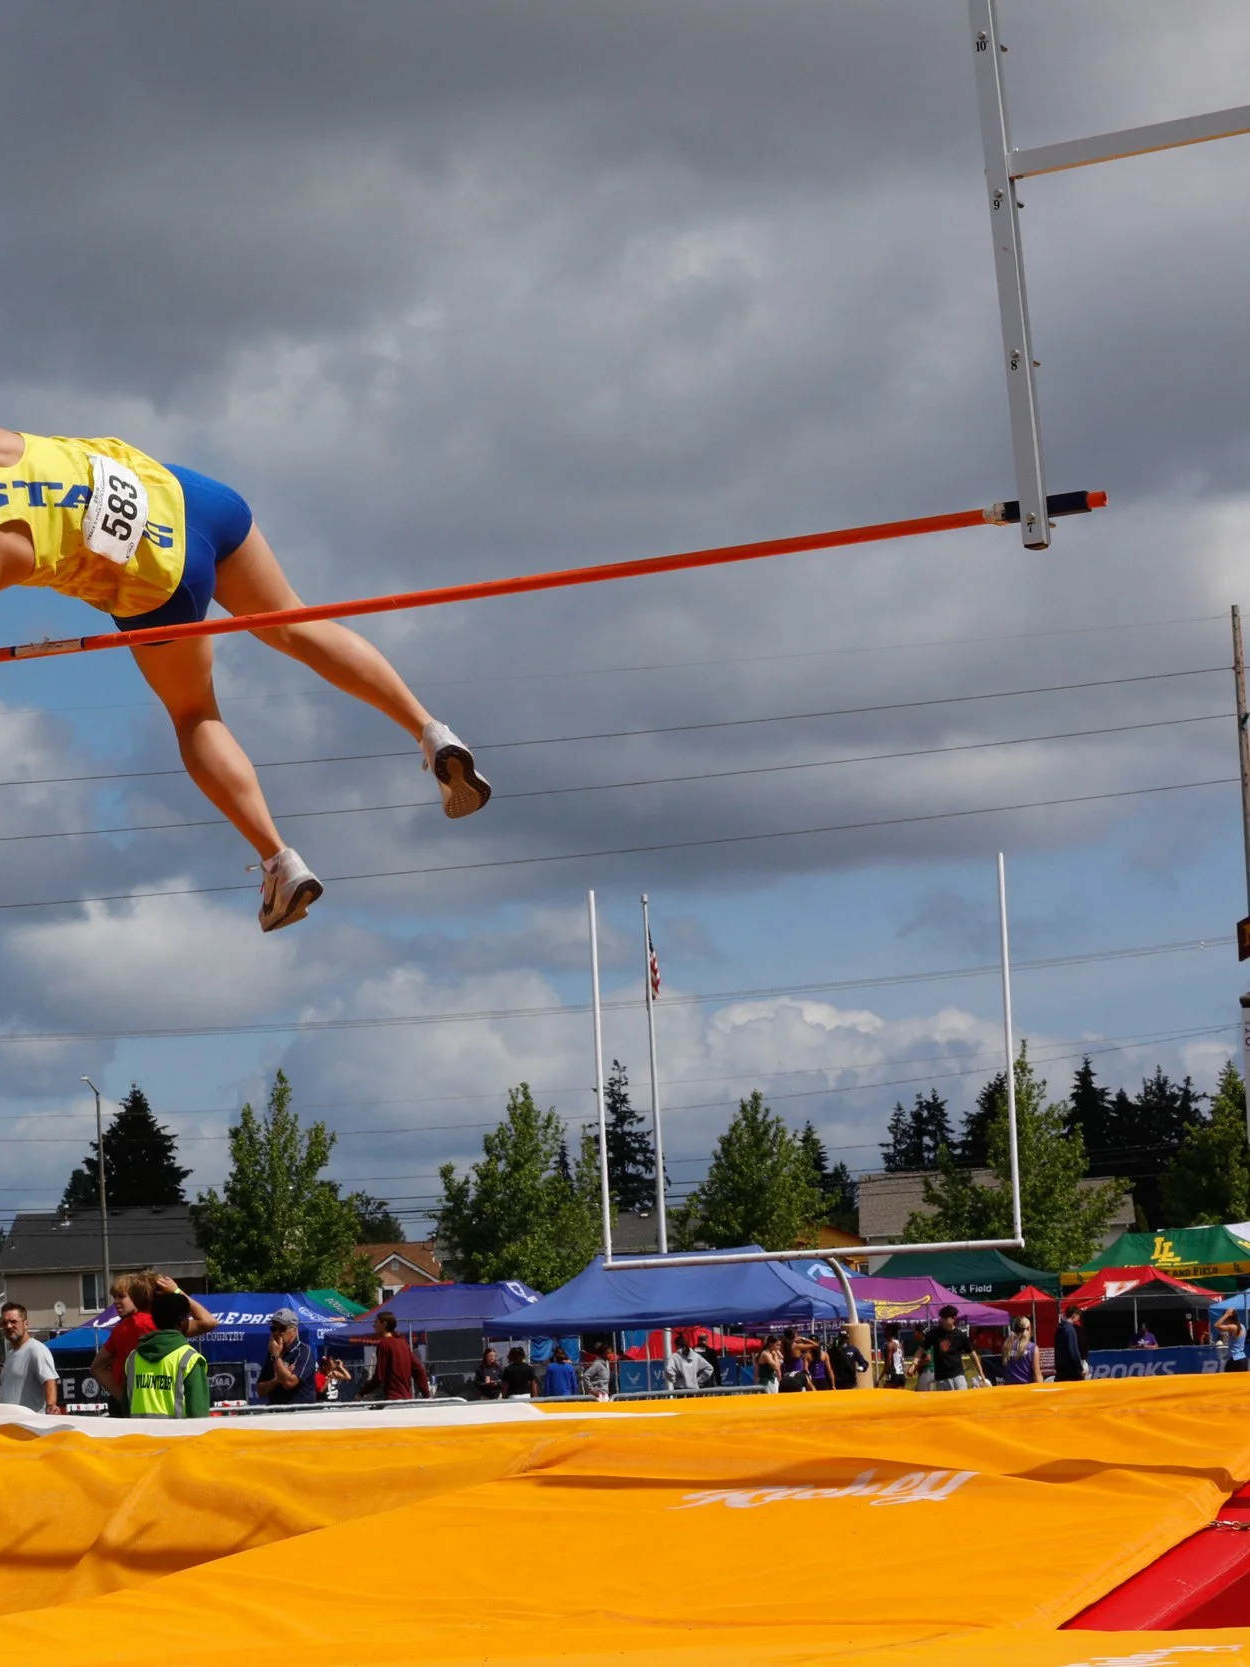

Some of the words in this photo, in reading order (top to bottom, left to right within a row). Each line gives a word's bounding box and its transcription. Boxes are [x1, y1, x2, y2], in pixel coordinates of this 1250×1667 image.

[976, 41, 986, 51] 10
[993, 200, 1000, 210] 9
[1011, 360, 1017, 370] 8
[101, 475, 138, 541] 583
[1151, 1237, 1181, 1262] LL
[1173, 1269, 1191, 1278] AND
[1193, 1266, 1219, 1276] FIELD
[959, 1285, 968, 1293] &
[969, 1284, 992, 1293] Field
[236, 1313, 274, 1325] PRE
[206, 1331, 246, 1341] COUNTRY
[1089, 1361, 1177, 1379] ROOKS
